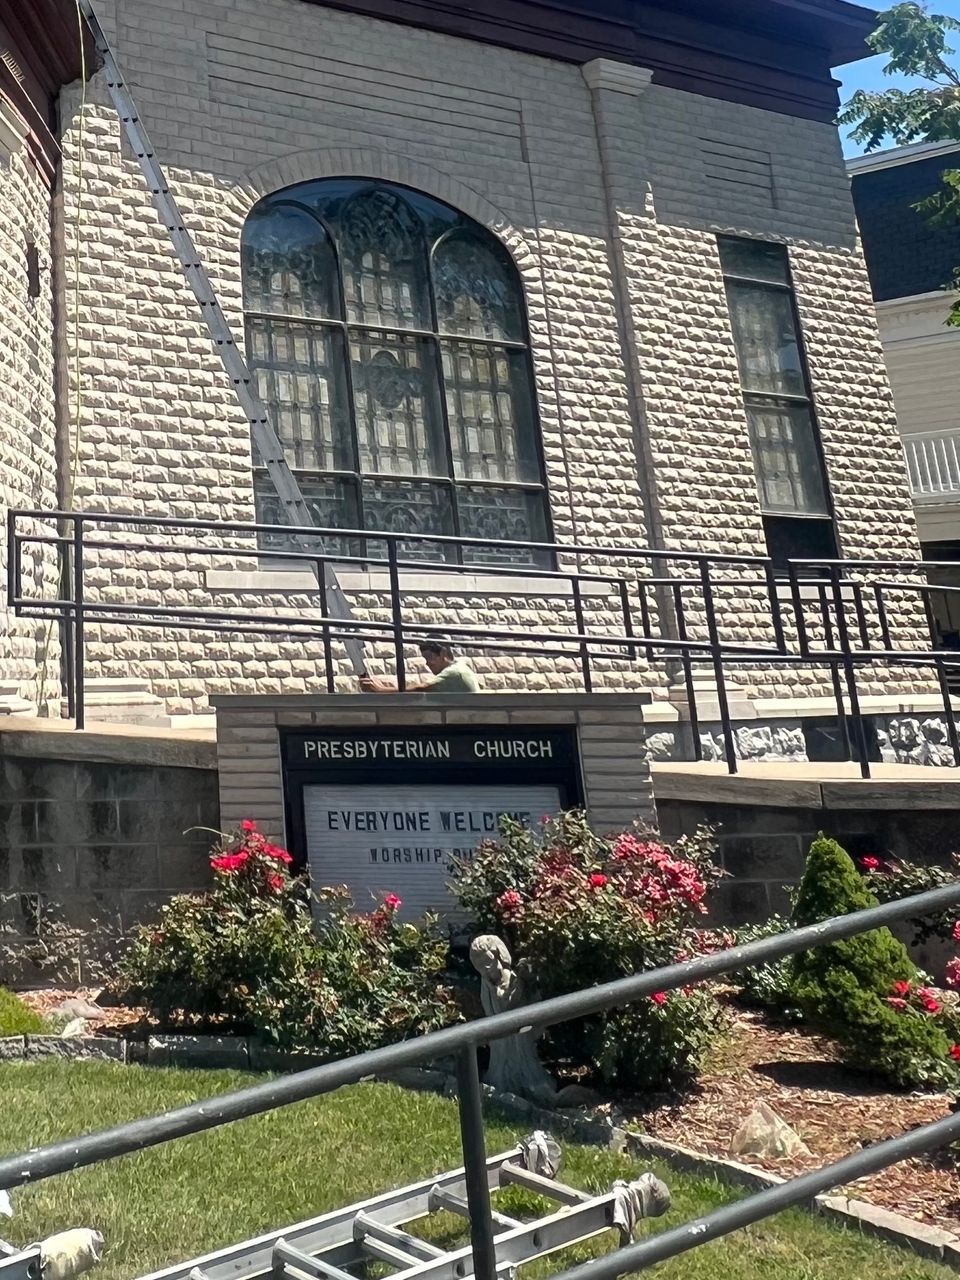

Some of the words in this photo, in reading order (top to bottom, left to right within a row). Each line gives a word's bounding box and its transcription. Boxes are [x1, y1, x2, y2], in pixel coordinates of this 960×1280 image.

[303, 740, 450, 759] PRESBYTERIAN
[473, 740, 553, 758] CHURCH
[327, 810, 431, 832] EVERYONE
[370, 848, 442, 863] WORSHIP
